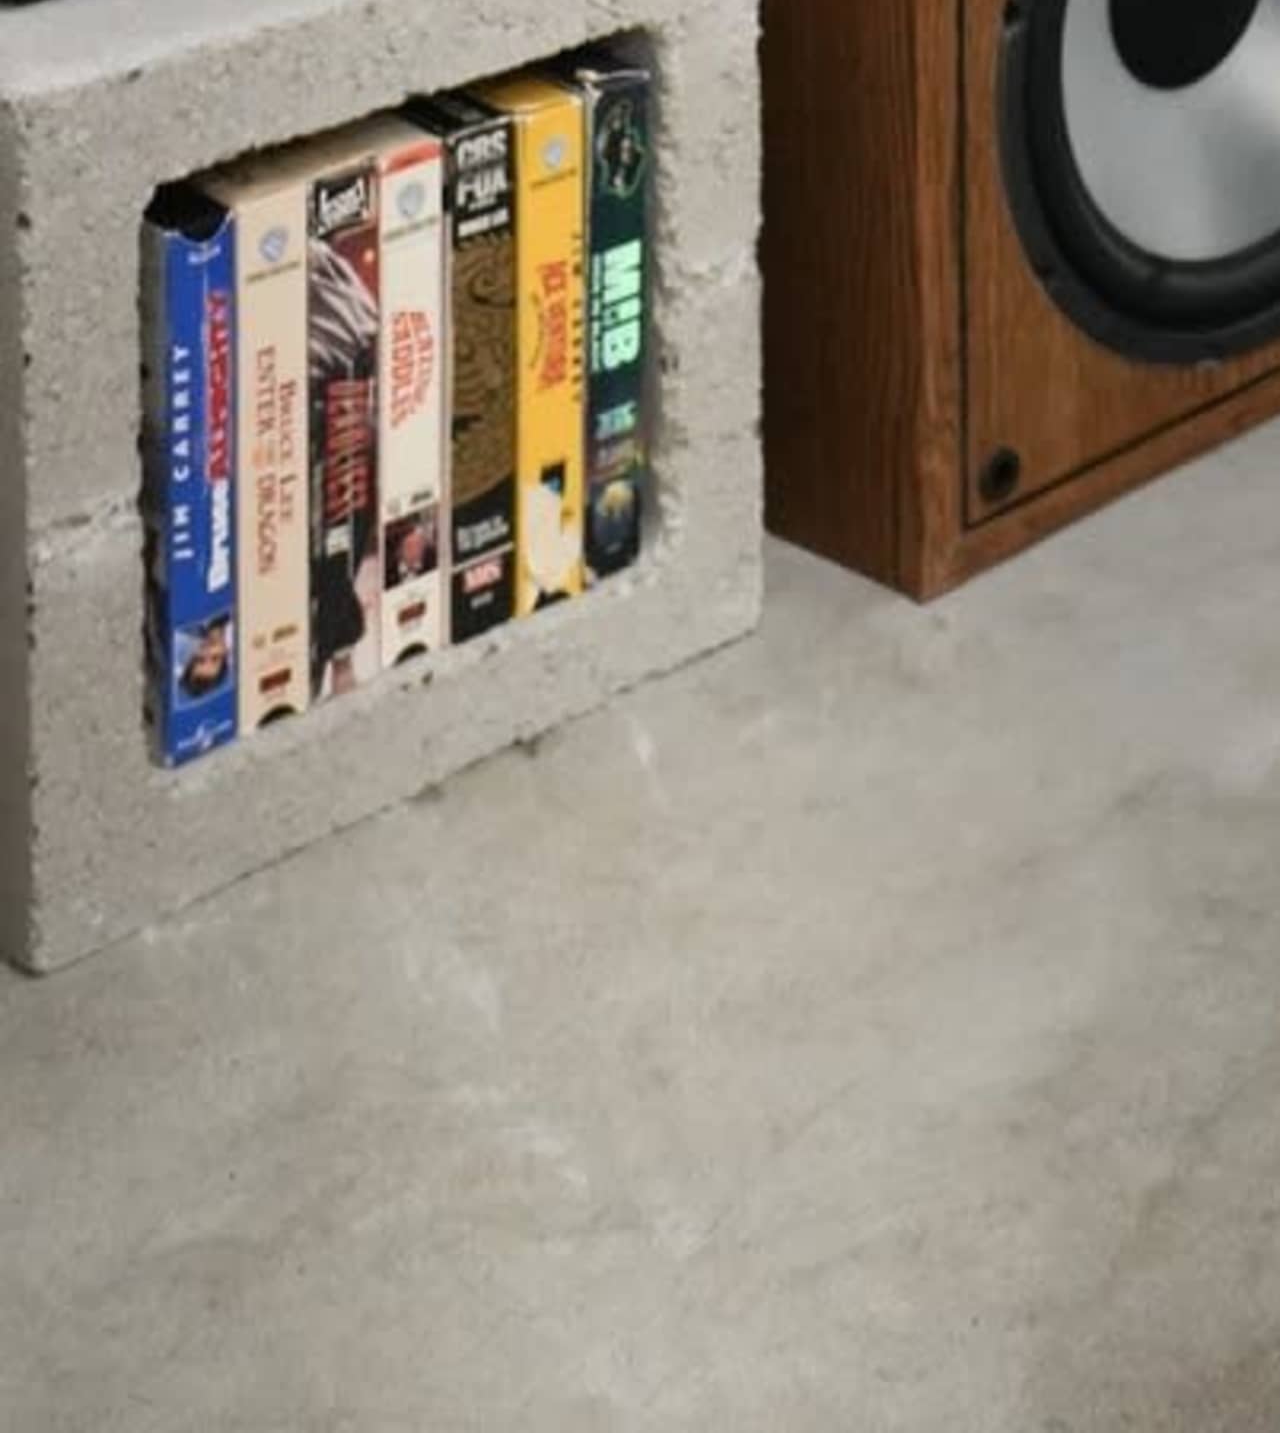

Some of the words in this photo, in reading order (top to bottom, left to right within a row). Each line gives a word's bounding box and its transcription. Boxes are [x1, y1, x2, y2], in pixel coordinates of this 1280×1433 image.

[171, 344, 191, 482] CARREY
[256, 345, 276, 437] ENTER
[172, 504, 194, 561] JIM
[257, 472, 277, 577] DRAGON
